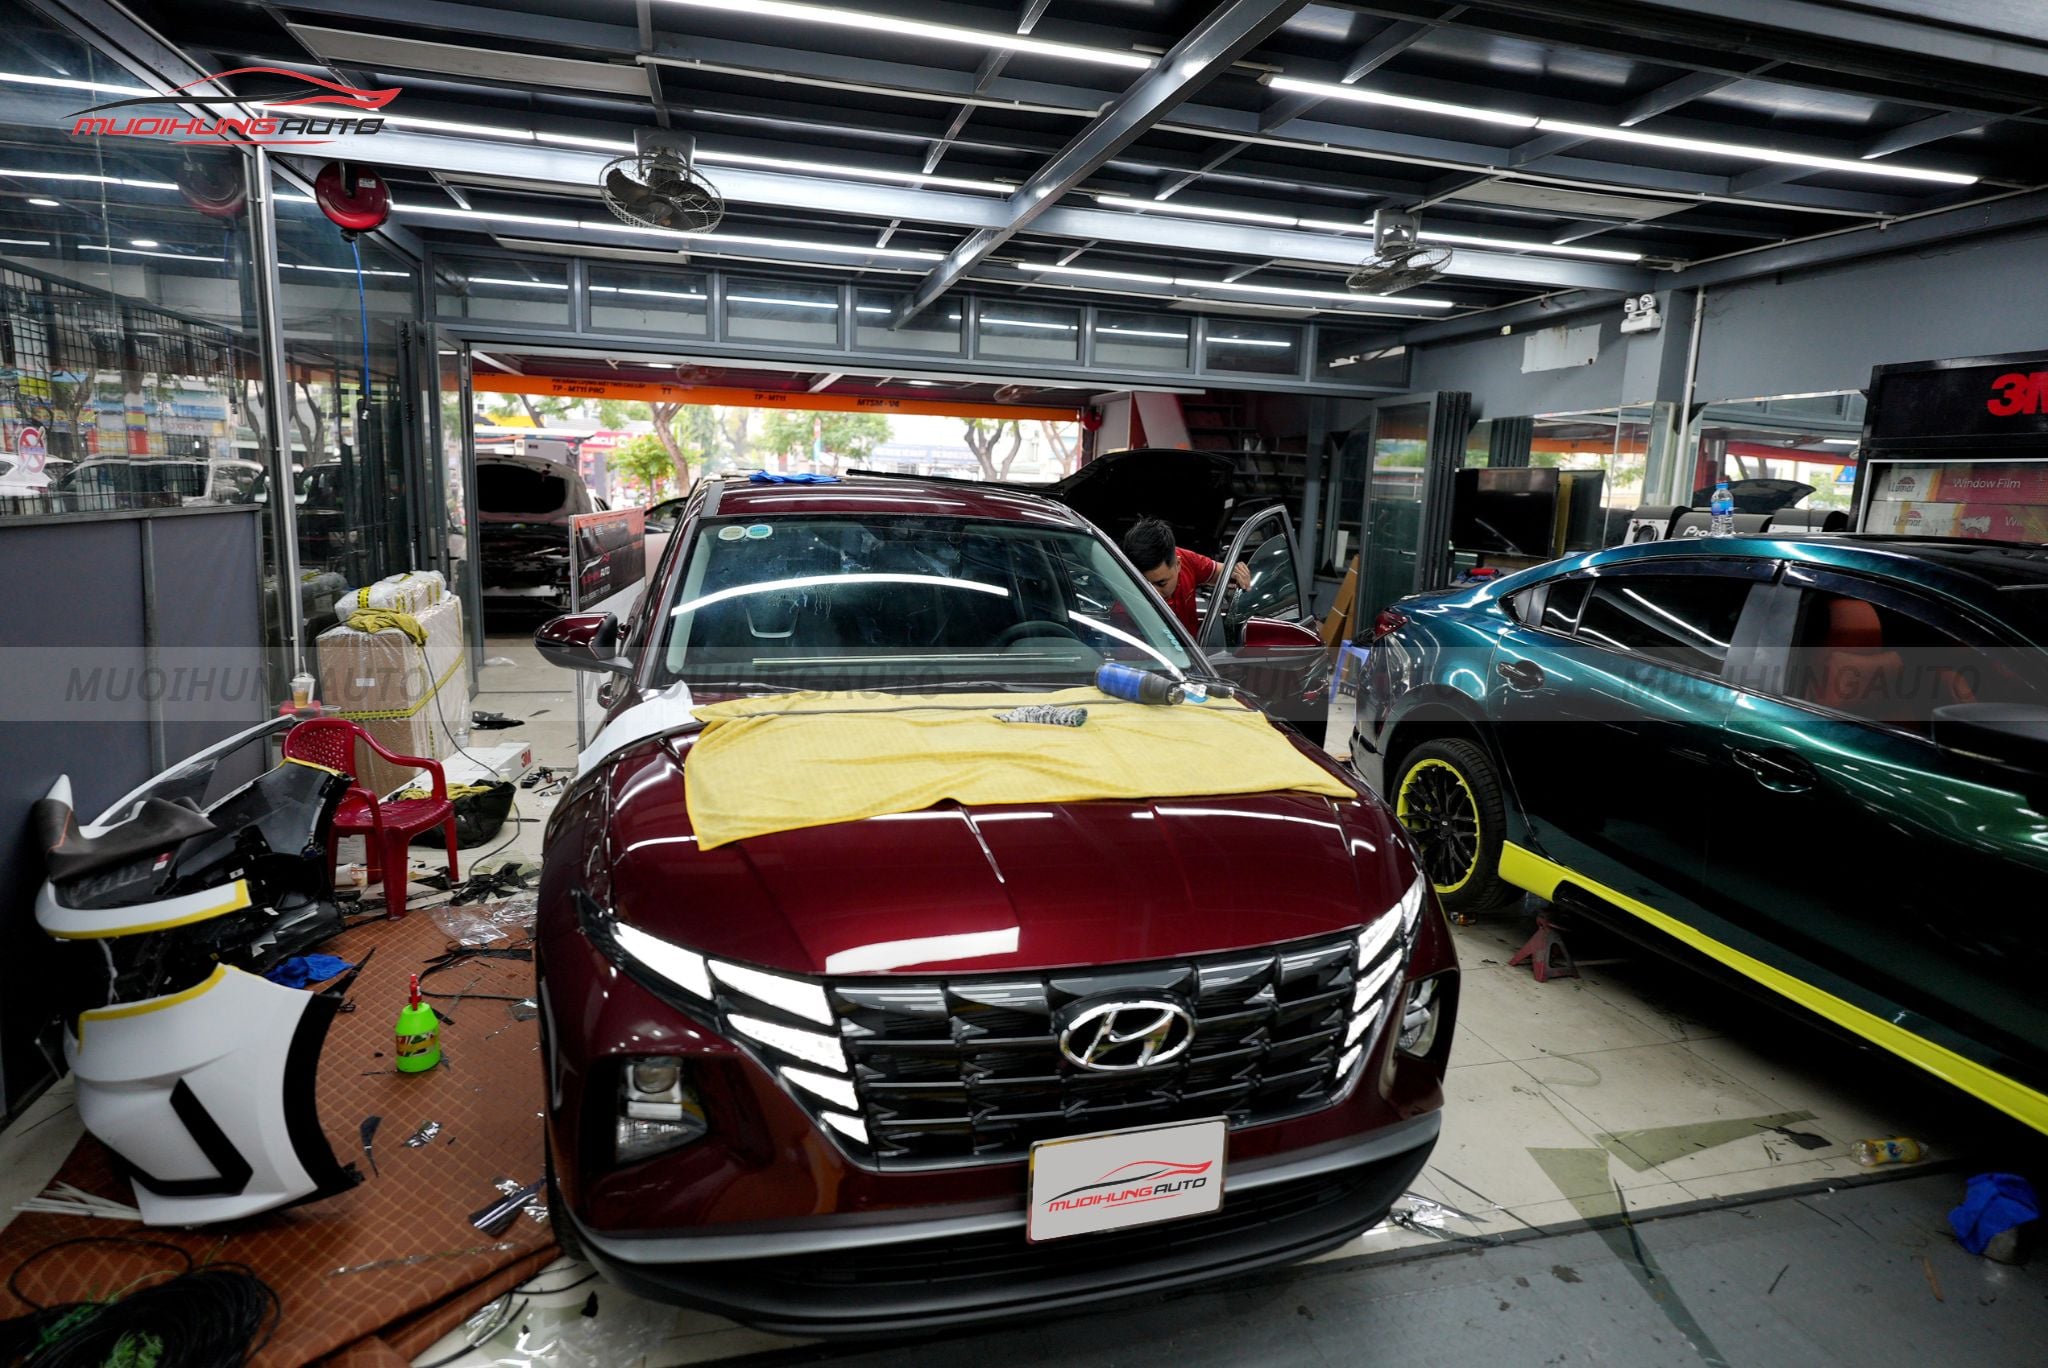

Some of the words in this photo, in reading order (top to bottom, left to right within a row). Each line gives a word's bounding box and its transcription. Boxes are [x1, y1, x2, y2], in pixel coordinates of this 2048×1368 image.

[1953, 478, 1996, 489] Window
[1996, 477, 2021, 488] Film
[521, 749, 532, 768] 3M
